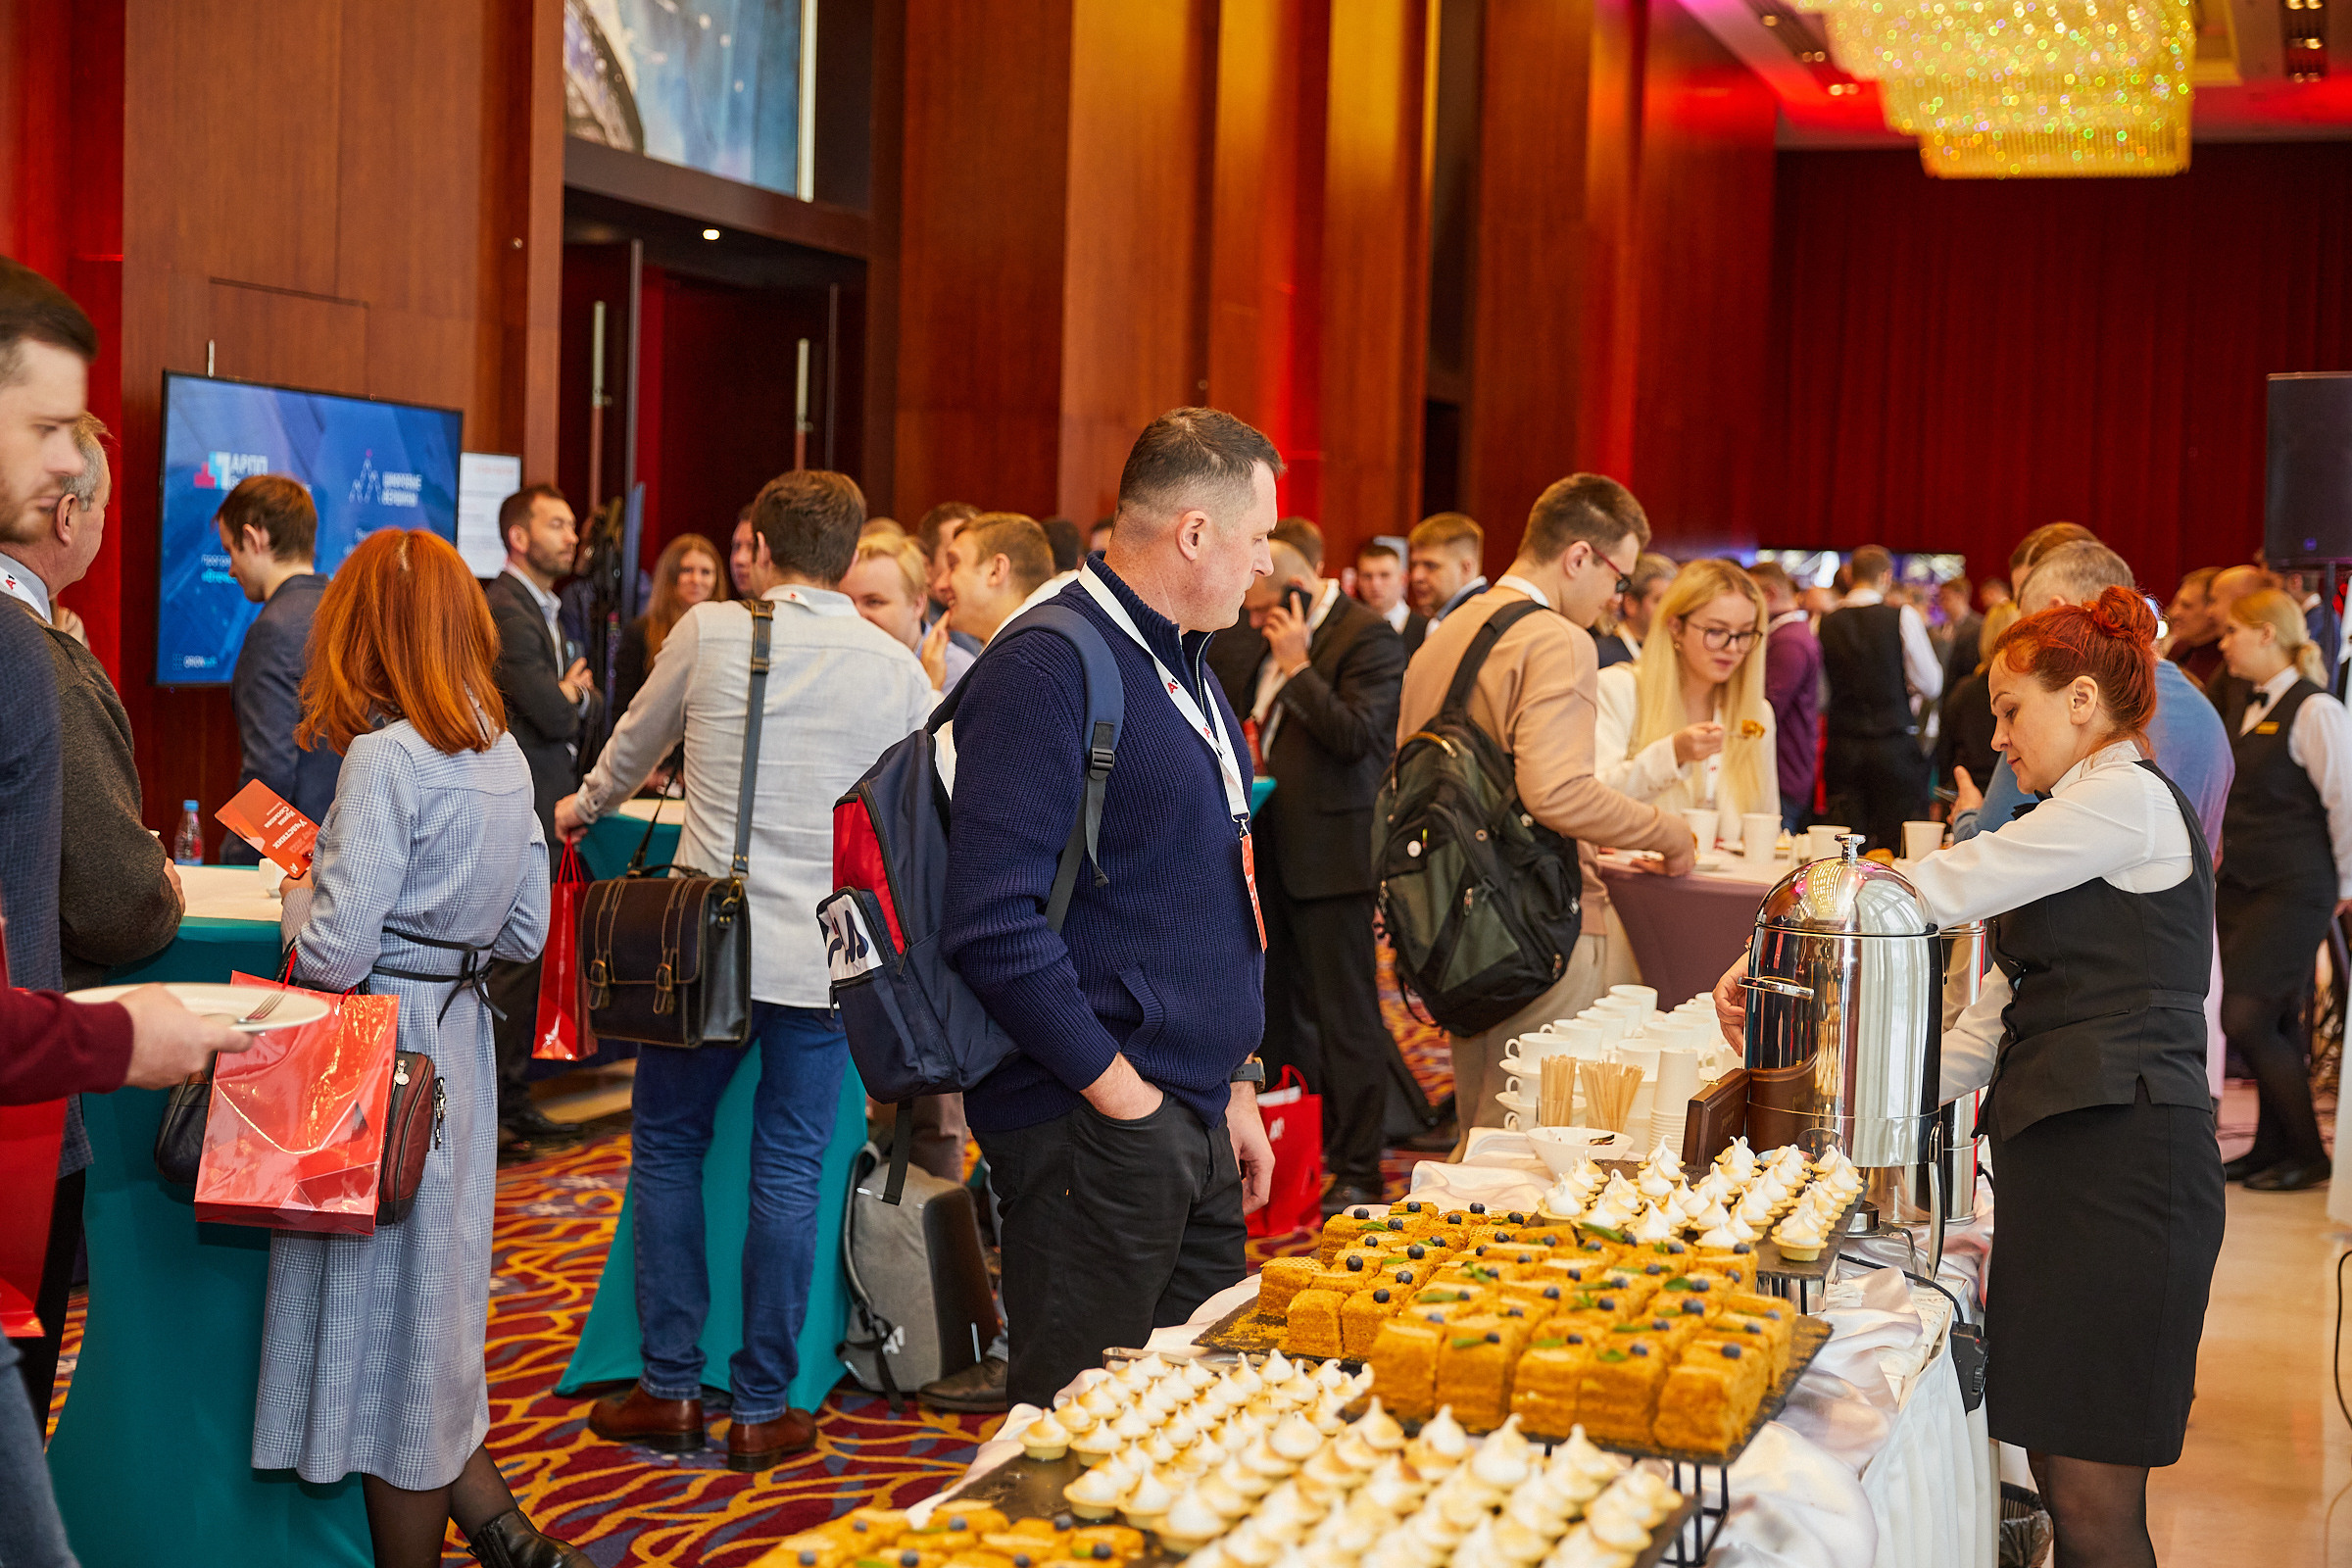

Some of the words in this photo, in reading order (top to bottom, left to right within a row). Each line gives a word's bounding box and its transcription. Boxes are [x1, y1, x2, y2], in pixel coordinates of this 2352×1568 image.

[5, 573, 17, 590] A1
[1167, 677, 1179, 694] A1
[272, 818, 308, 850] Участник
